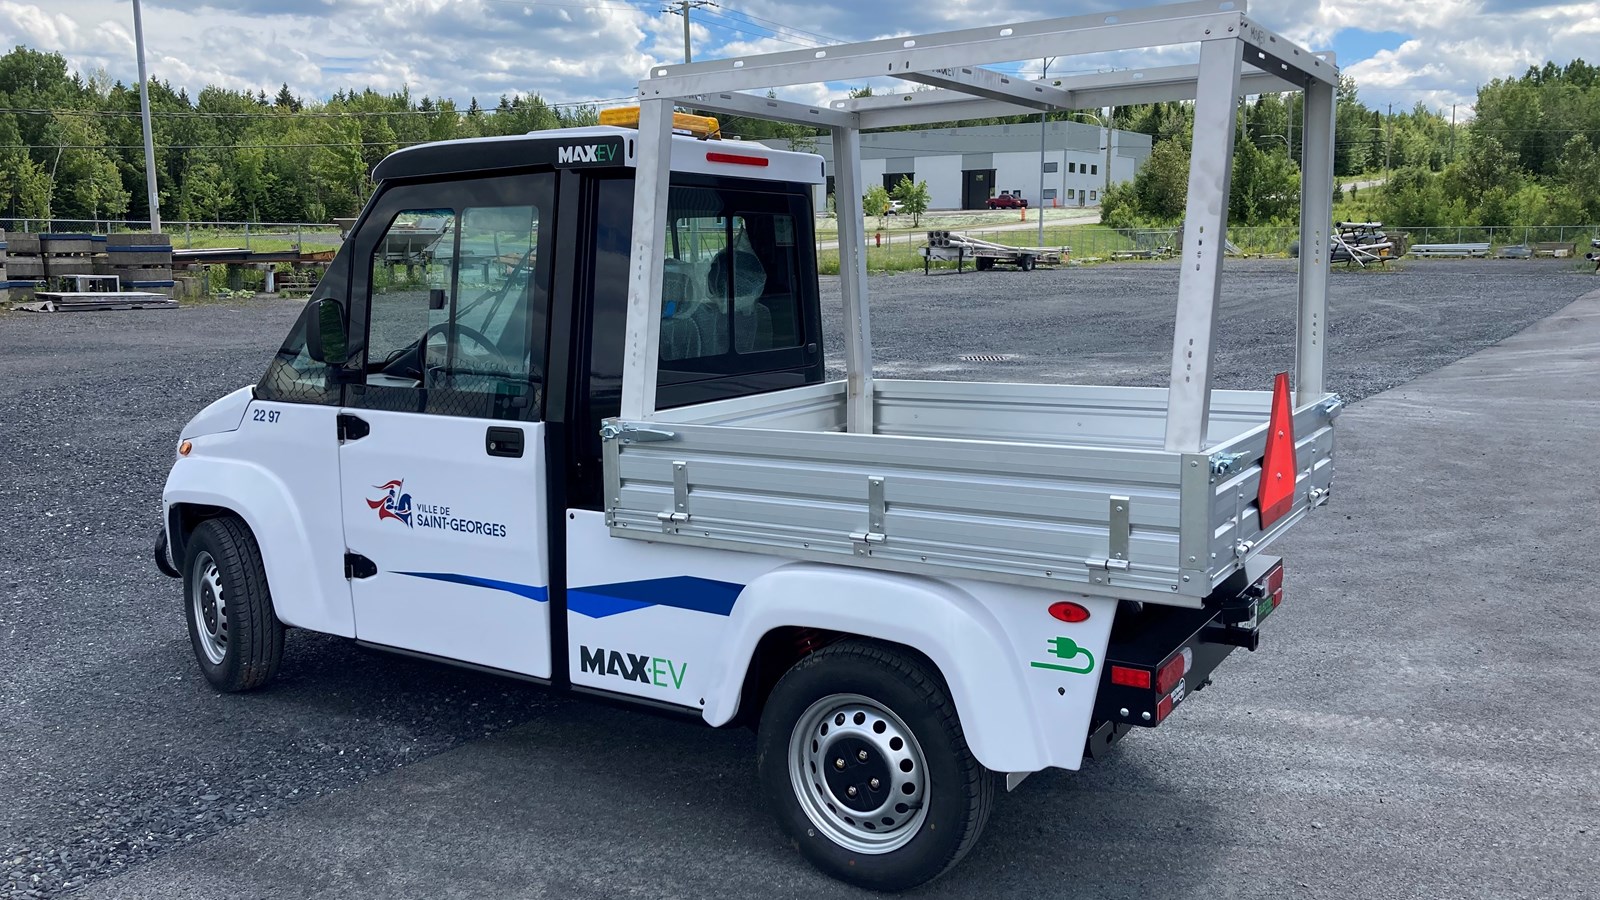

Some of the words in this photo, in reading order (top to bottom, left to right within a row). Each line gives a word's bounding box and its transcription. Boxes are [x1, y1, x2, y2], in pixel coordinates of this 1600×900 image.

[253, 409, 266, 422] 22
[268, 410, 281, 423] 97
[416, 503, 438, 514] VILLE
[440, 506, 451, 516] DE
[417, 514, 507, 537] SAINT-GEORGES
